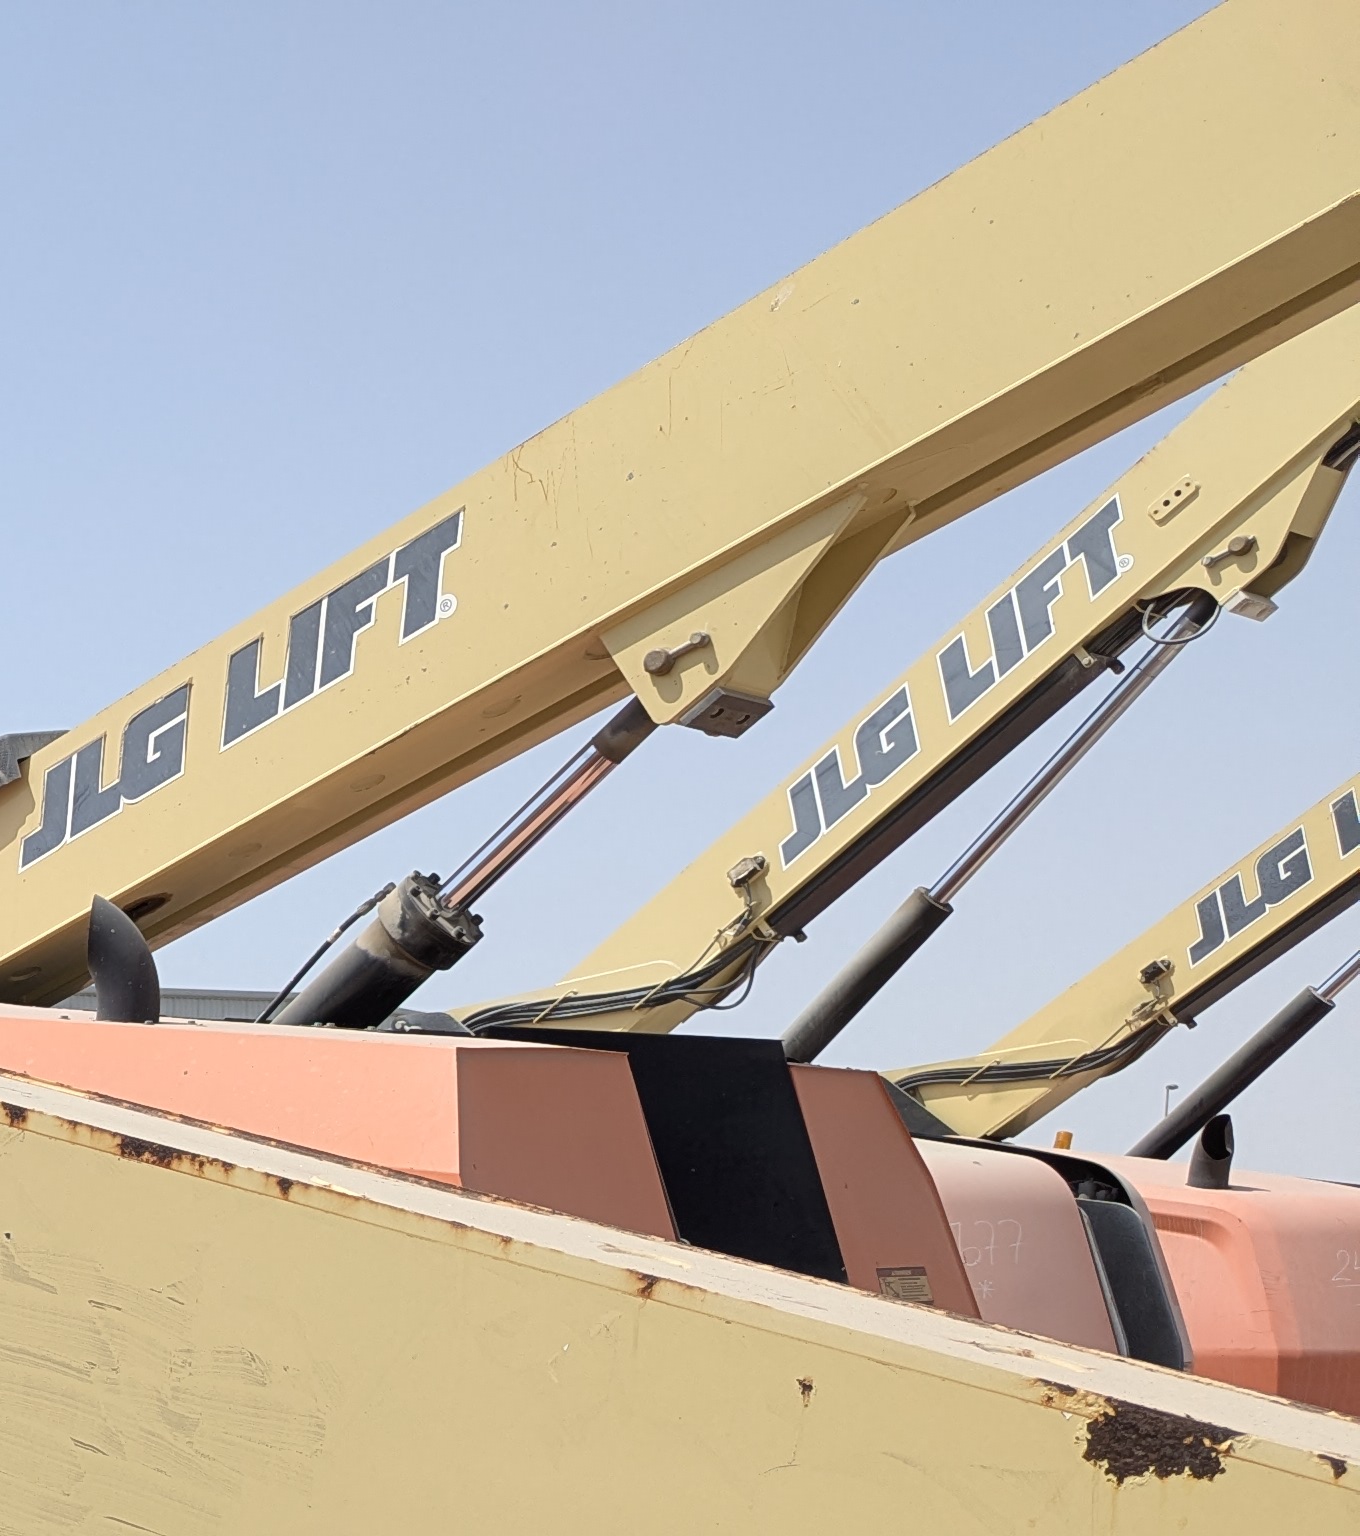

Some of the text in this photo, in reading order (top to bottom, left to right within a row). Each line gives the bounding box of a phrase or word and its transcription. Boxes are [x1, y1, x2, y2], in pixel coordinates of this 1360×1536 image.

[18, 505, 465, 873] JLG LIFT
[779, 493, 1124, 870] JLG LIFT
[1187, 824, 1314, 969] JLG
